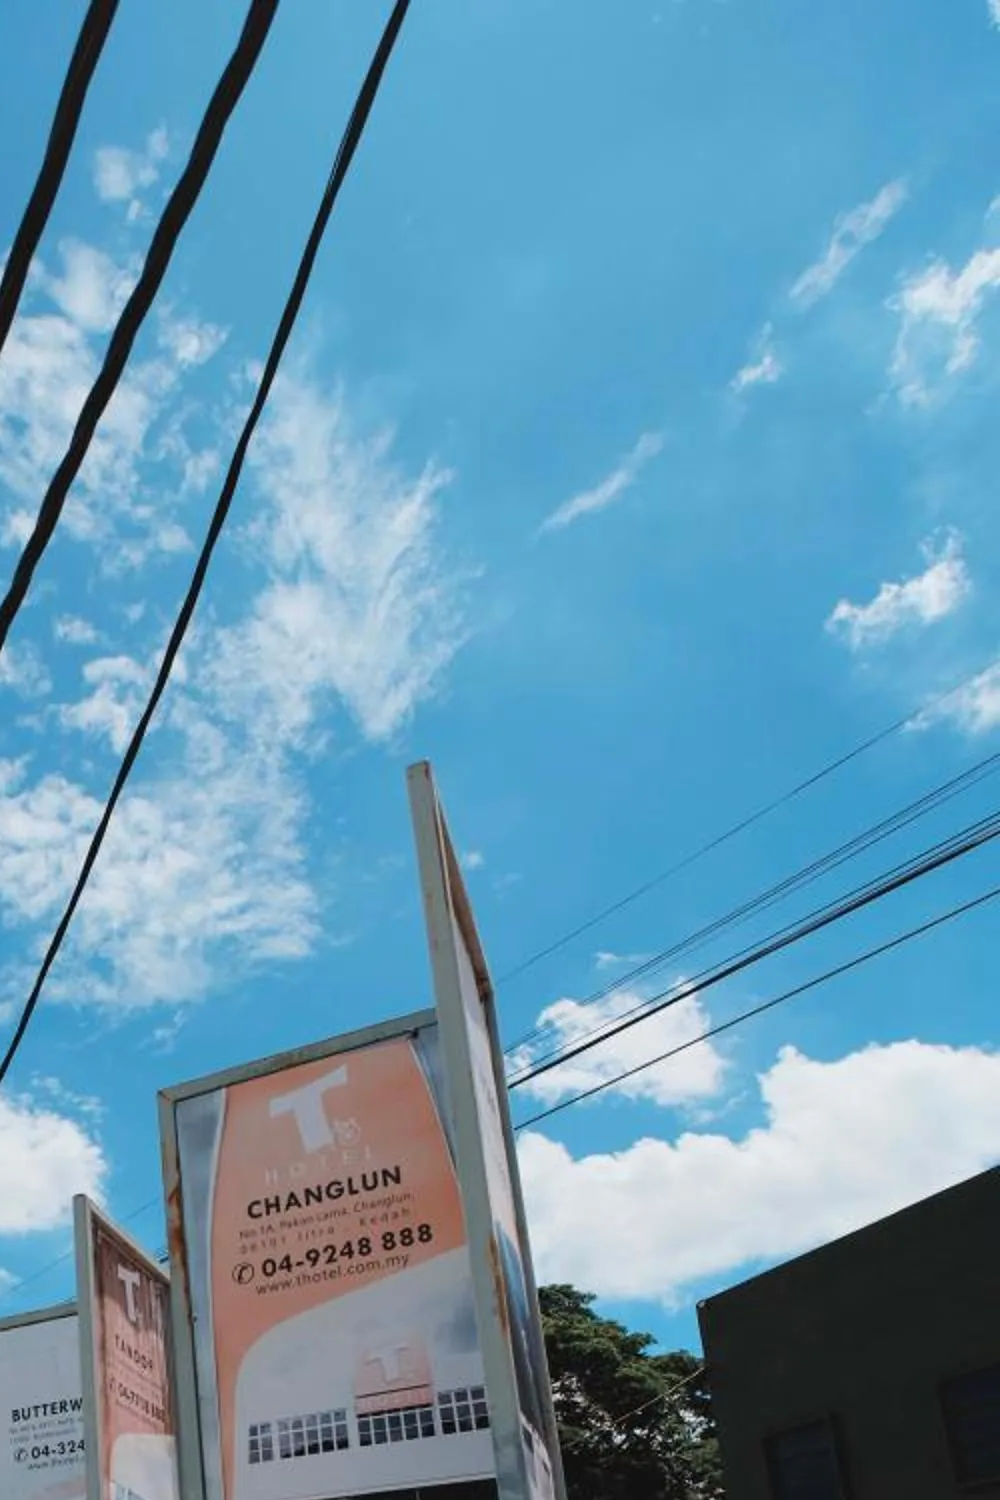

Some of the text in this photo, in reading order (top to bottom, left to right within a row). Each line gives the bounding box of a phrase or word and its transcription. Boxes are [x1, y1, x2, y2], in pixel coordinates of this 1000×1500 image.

[268, 1063, 348, 1154] T
[247, 1165, 402, 1219] CHANGLUN
[255, 1252, 410, 1296] www.thotel.com.my
[261, 1223, 434, 1277] 04-9248 888
[11, 1396, 84, 1423] BUTTERW
